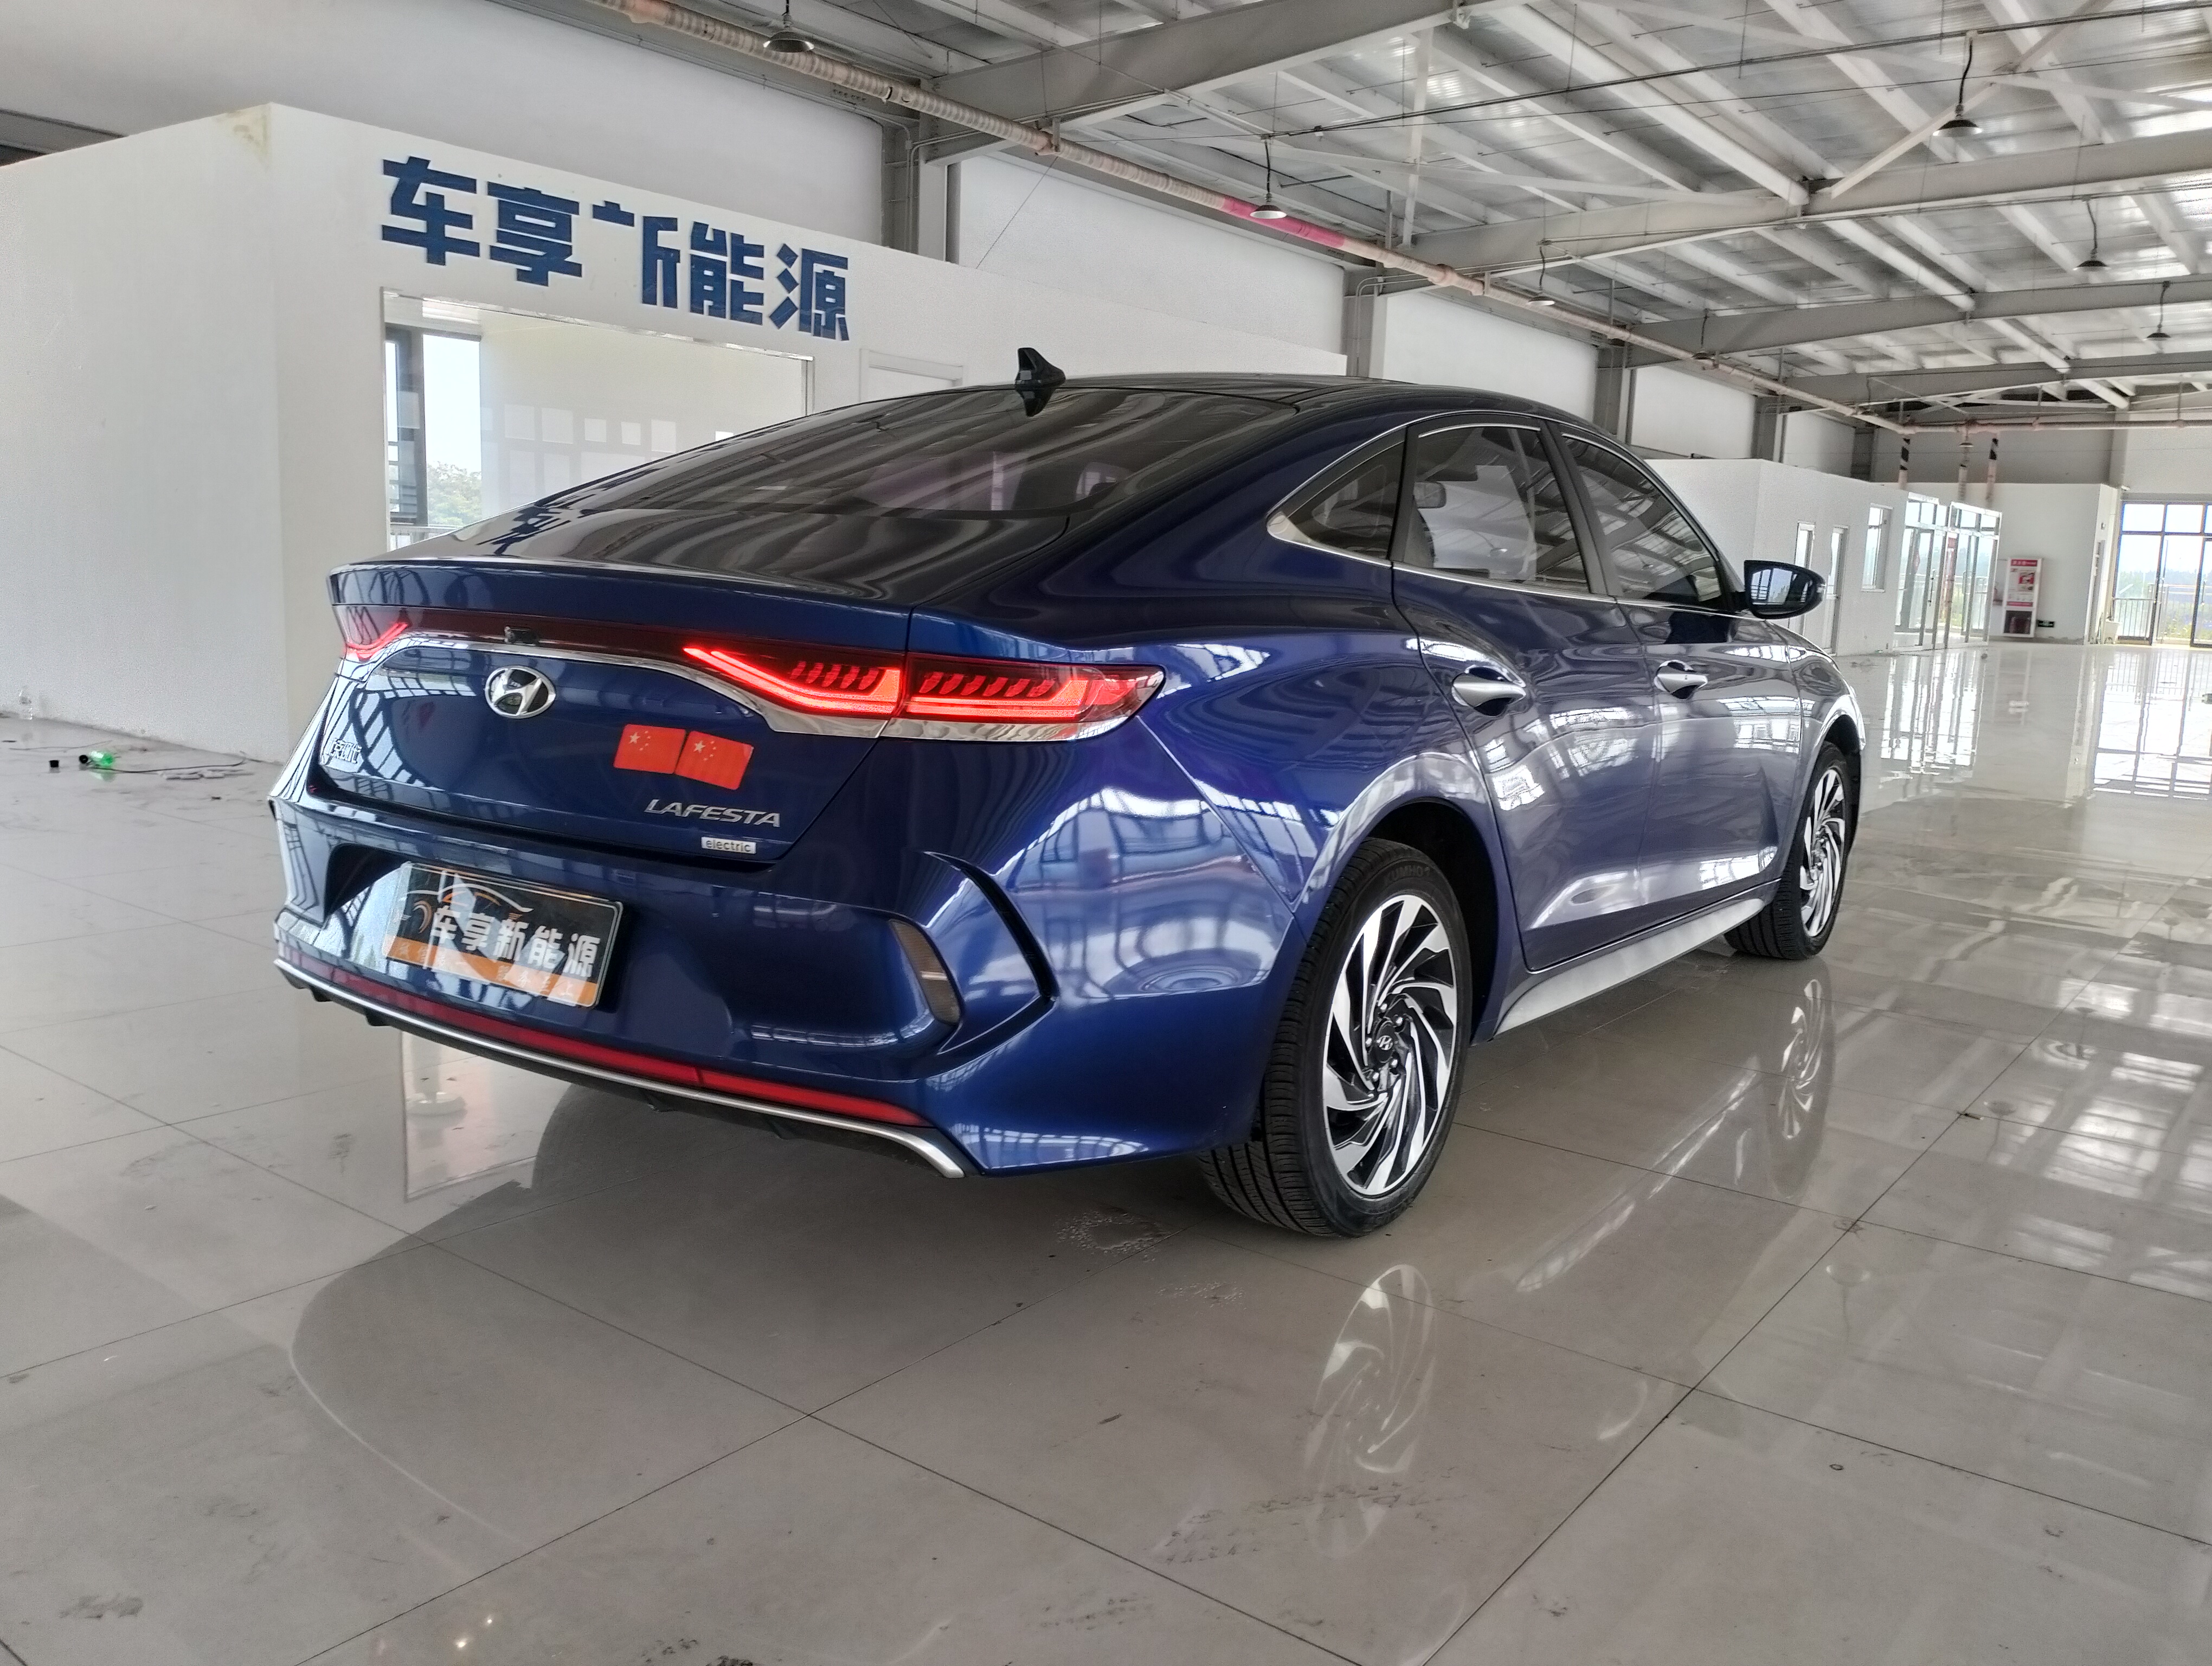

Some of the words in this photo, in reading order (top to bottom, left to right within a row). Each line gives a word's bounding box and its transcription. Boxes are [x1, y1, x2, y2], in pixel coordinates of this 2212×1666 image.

[644, 799, 780, 828] LAFESTA
[705, 840, 751, 853] electric
[430, 905, 600, 977] 车享新能源
